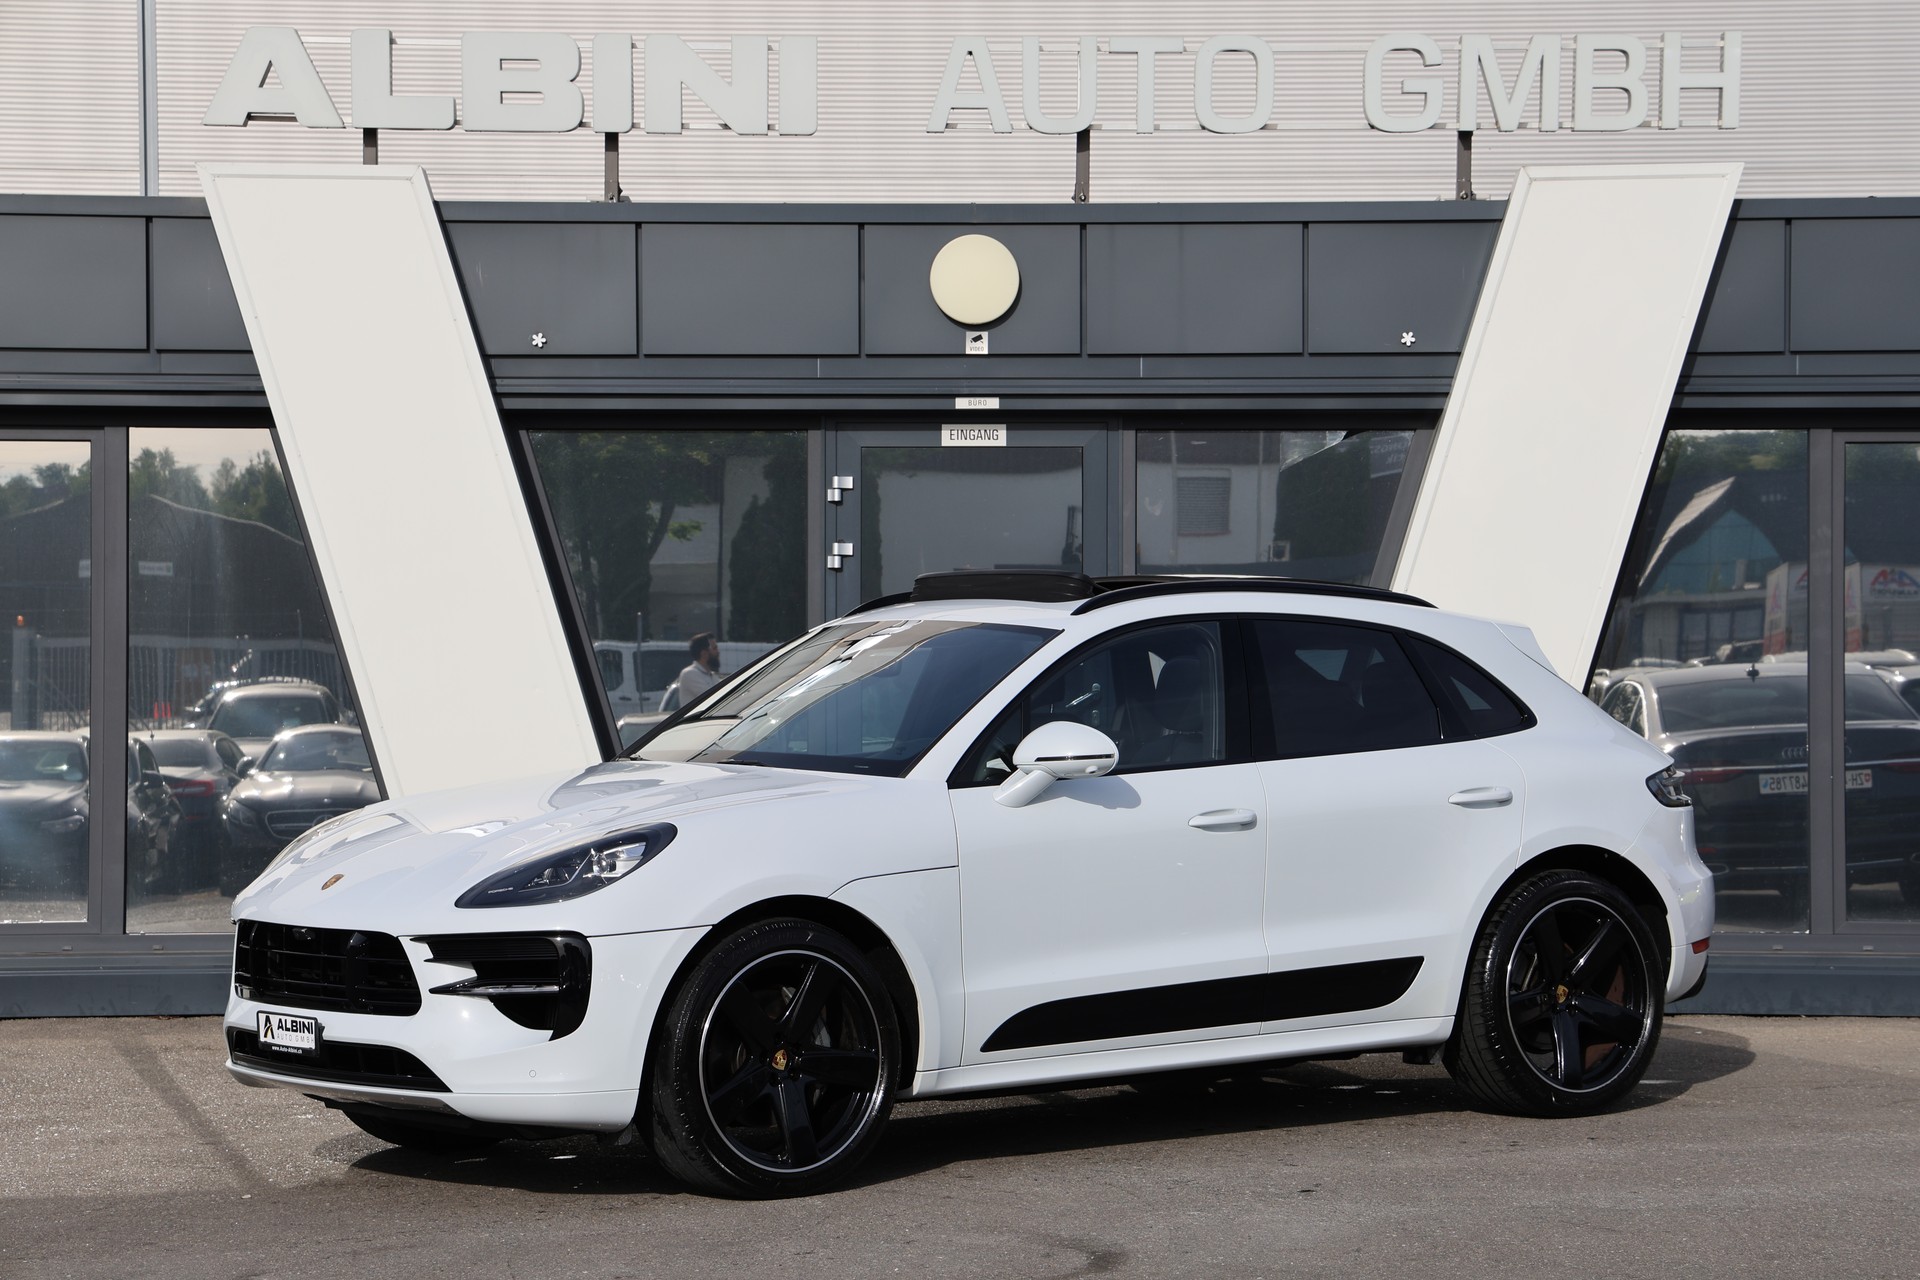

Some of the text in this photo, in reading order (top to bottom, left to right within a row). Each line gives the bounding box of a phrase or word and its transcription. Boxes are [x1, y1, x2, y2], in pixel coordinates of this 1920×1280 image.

[201, 26, 1742, 136] ALBINI AUTO GMBH
[967, 399, 988, 407] BÜRO
[949, 428, 999, 441] EINGANG
[277, 1018, 313, 1034] ALBINI
[277, 1033, 292, 1041] AUTO
